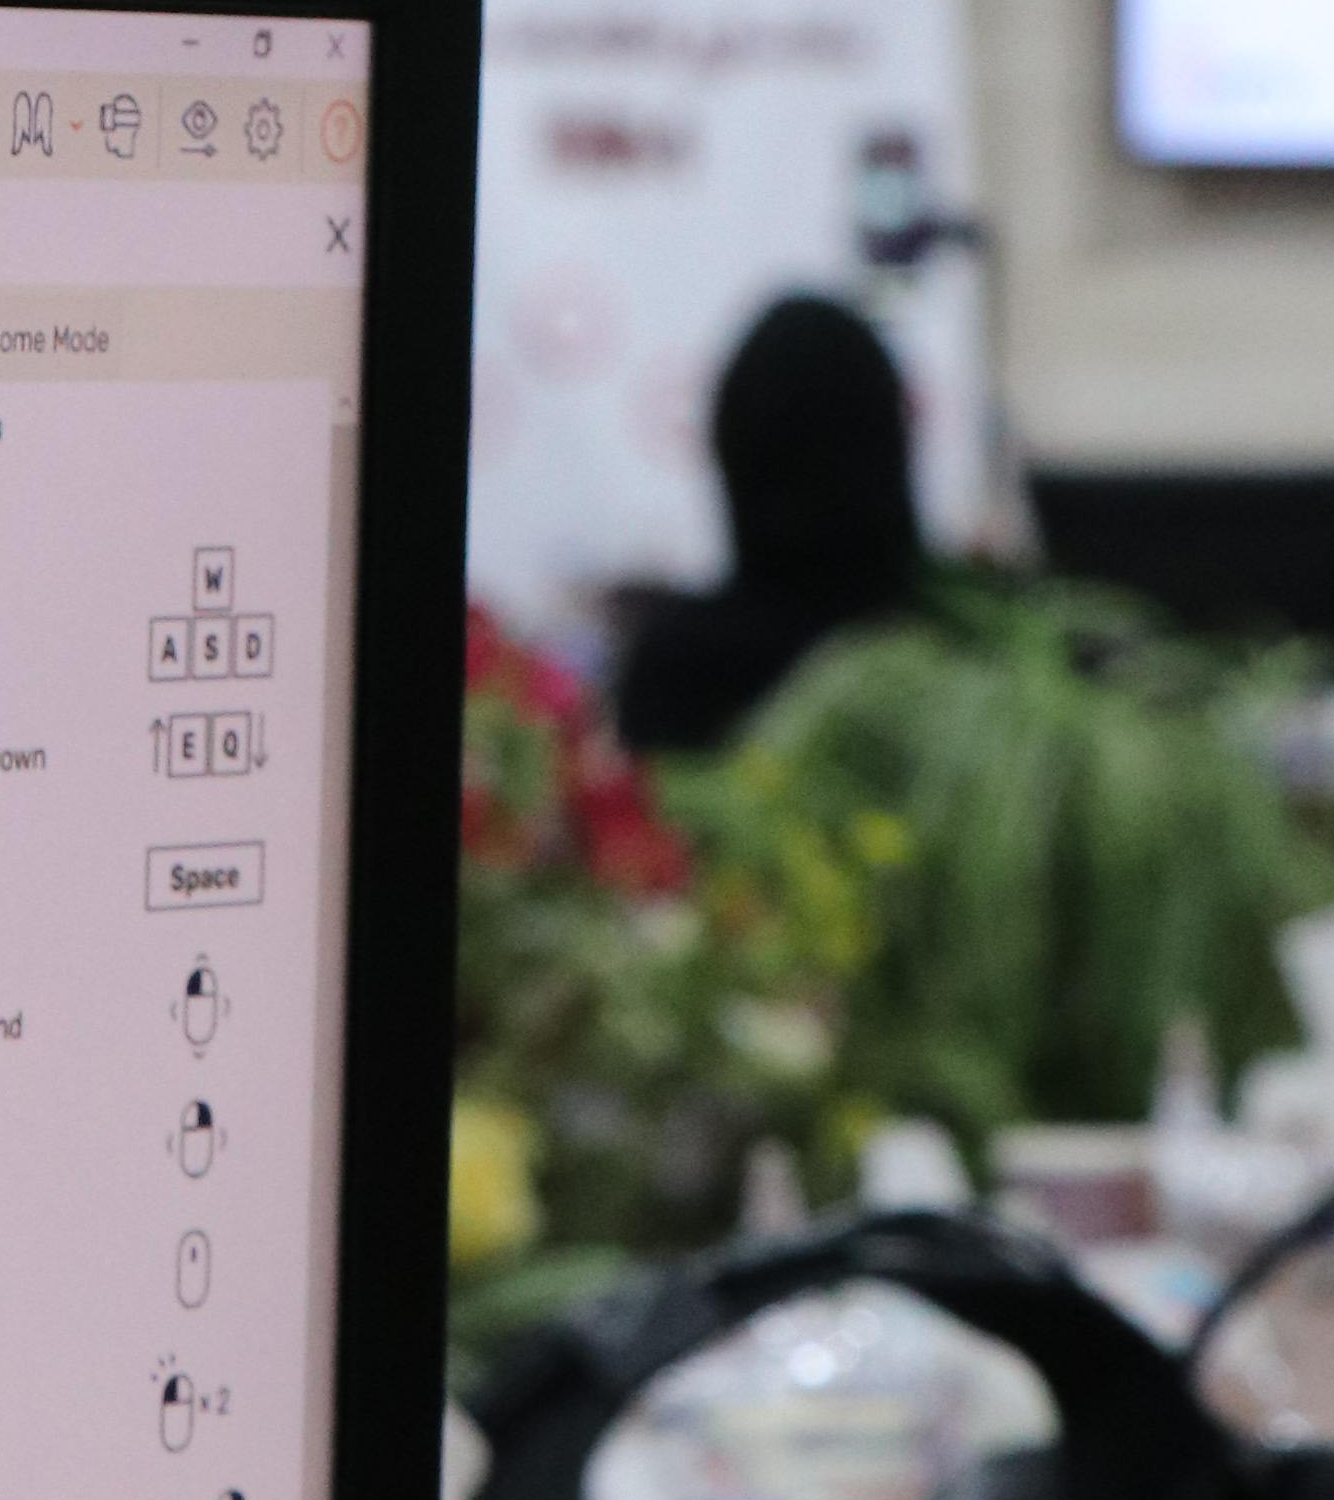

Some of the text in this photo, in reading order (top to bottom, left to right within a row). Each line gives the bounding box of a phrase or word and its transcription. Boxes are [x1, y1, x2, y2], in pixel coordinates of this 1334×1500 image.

[53, 325, 109, 353] Mode
[205, 567, 222, 592] W
[161, 633, 260, 661] A S D
[183, 731, 237, 759] E Q
[171, 862, 240, 894] Space
